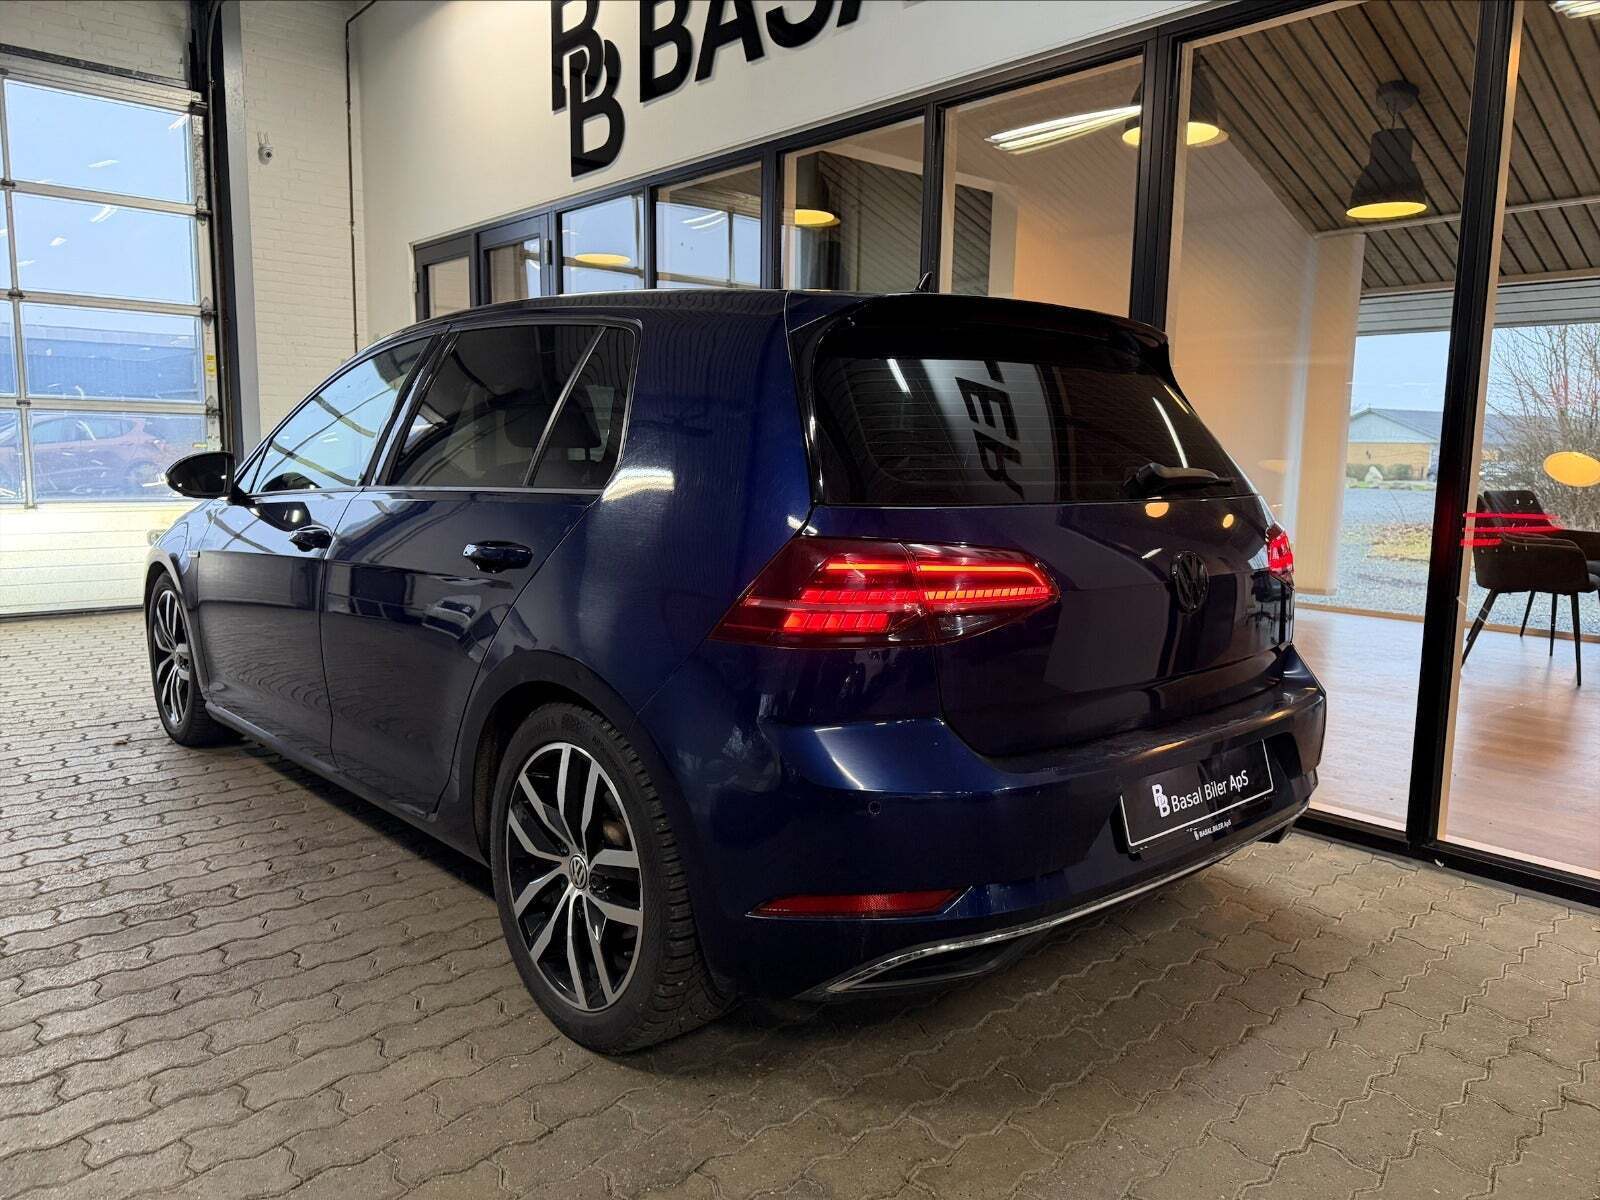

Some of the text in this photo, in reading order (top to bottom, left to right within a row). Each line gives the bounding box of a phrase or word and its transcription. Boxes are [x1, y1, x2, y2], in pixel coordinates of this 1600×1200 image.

[1171, 787, 1202, 812] Basal
[1204, 780, 1227, 801] Biler
[1230, 769, 1249, 792] ApS
